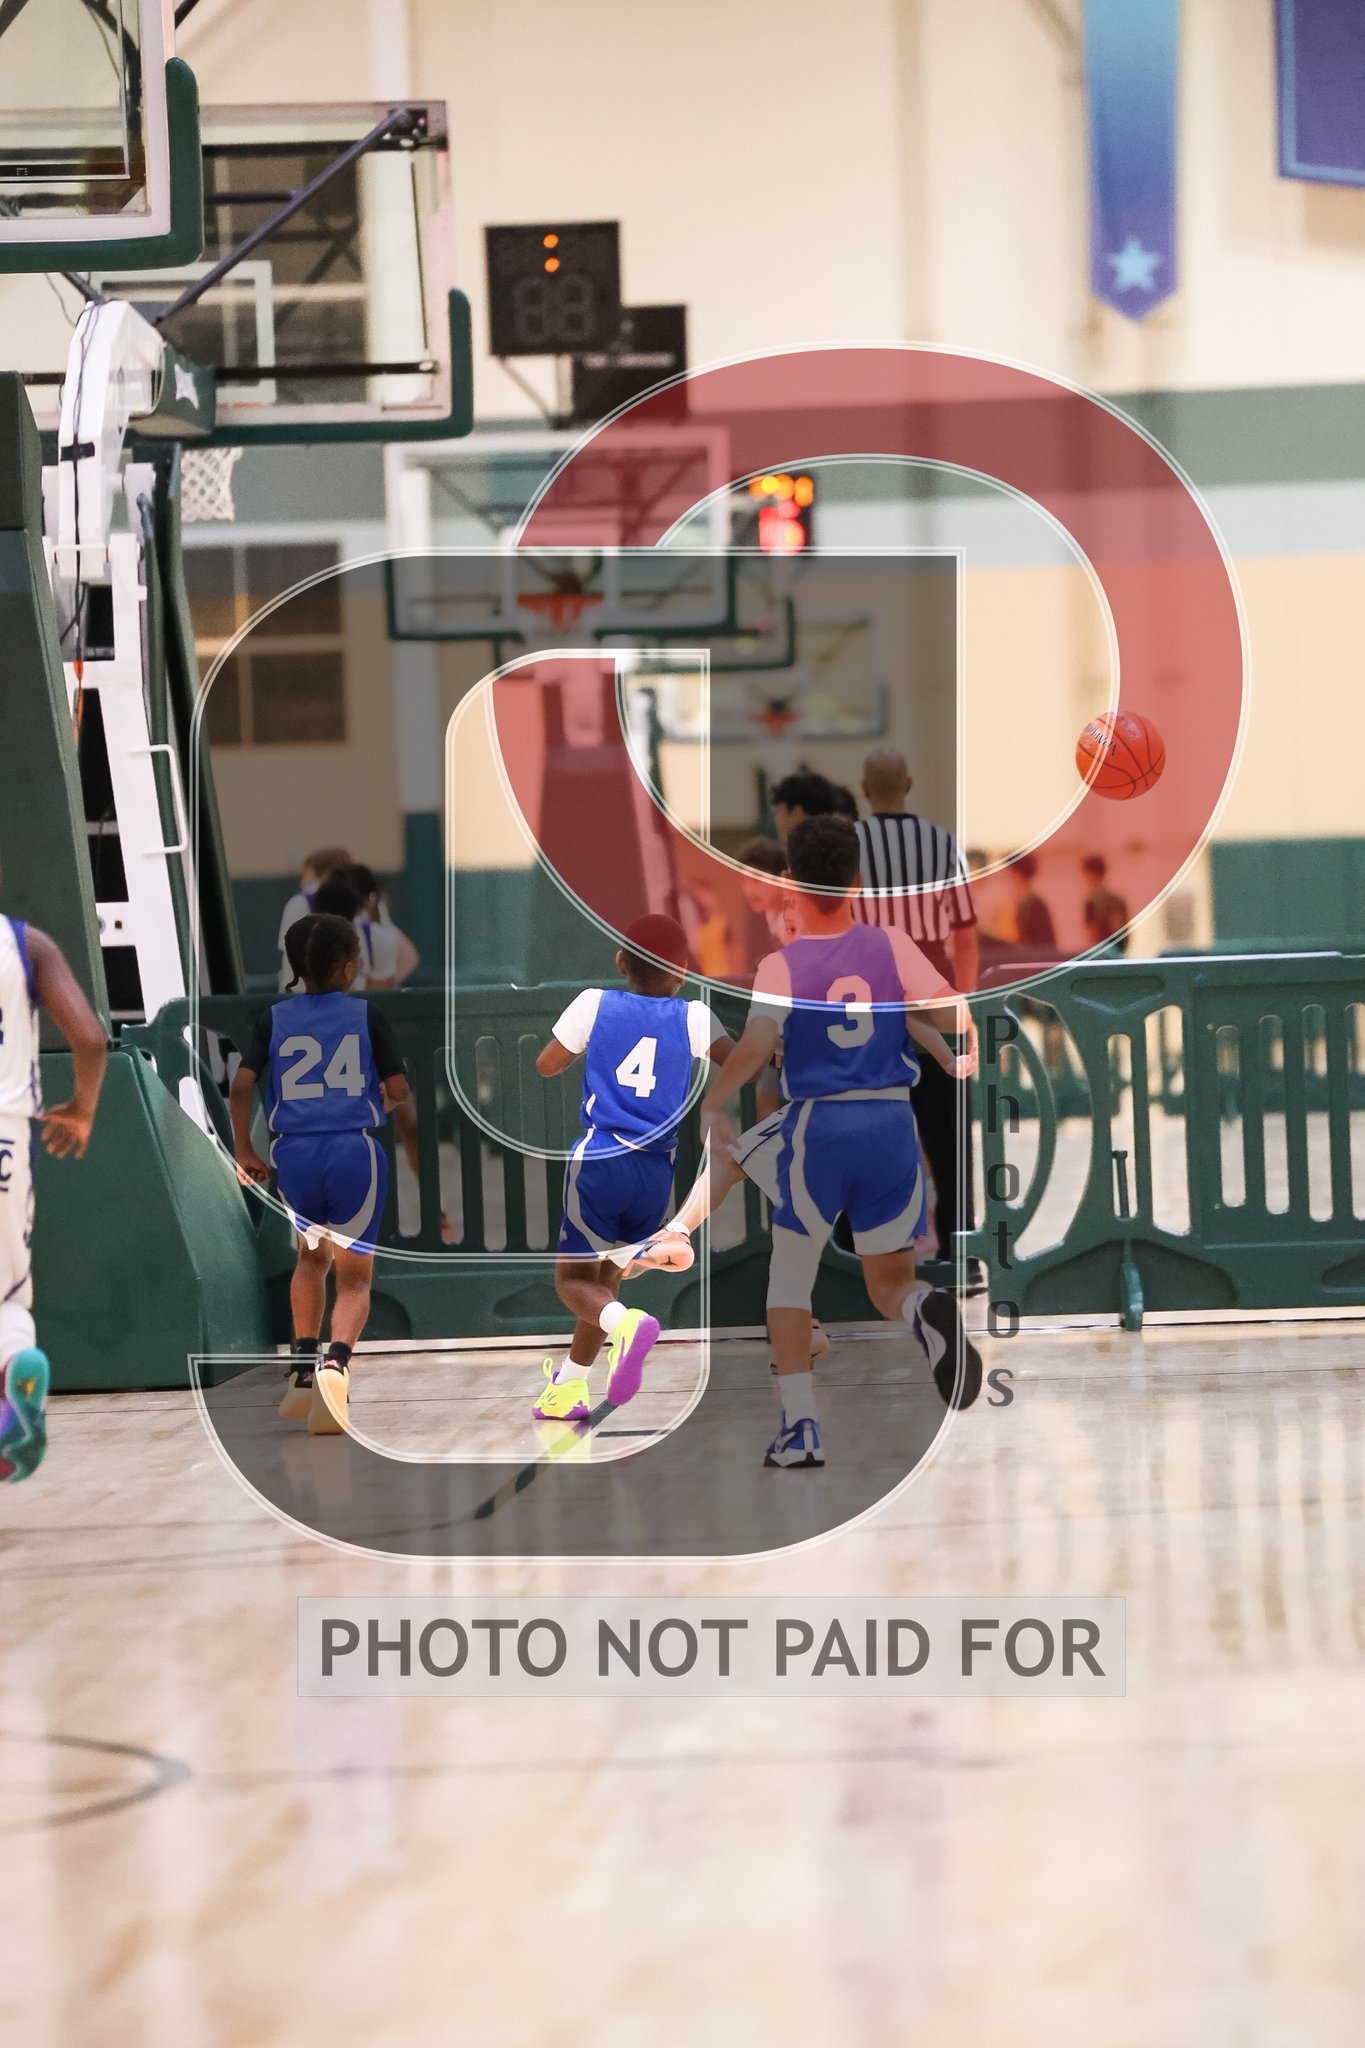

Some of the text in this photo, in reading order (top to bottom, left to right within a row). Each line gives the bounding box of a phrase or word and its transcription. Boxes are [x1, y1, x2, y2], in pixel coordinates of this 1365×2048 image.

[826, 974, 875, 1049] 3
[278, 1034, 366, 1101] 24
[615, 1036, 658, 1098] 4
